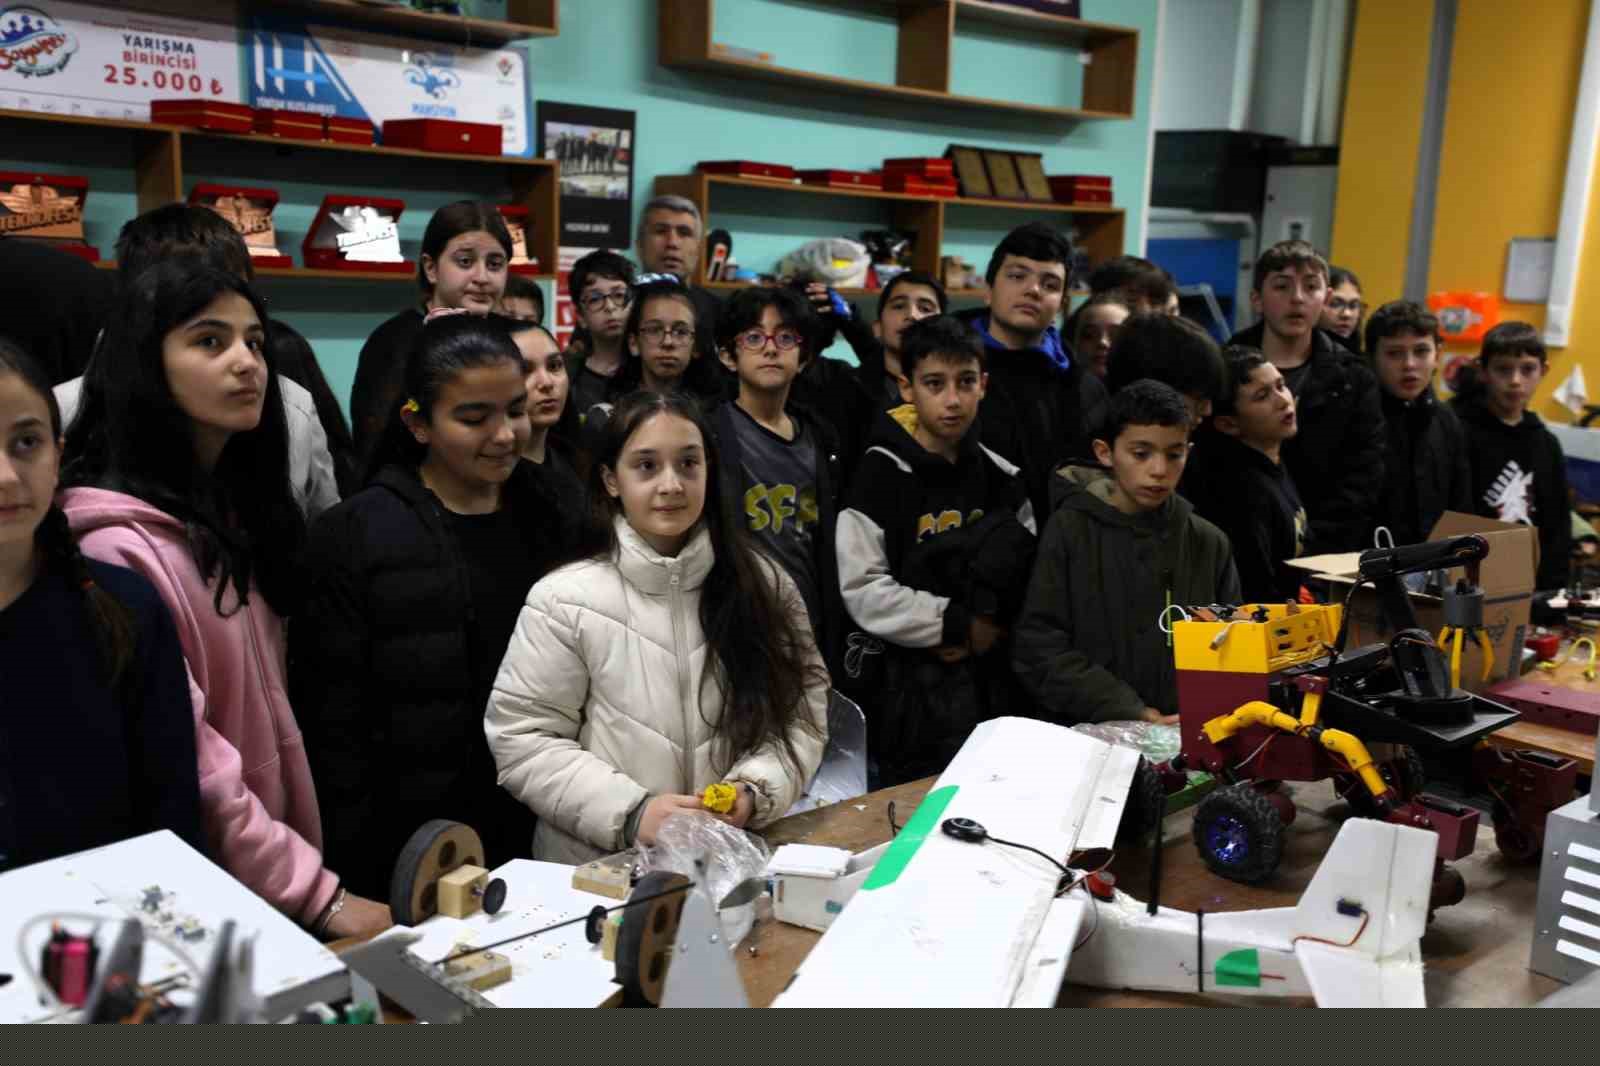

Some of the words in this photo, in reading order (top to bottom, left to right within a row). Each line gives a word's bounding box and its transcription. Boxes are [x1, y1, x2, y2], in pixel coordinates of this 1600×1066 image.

[122, 33, 196, 54] YARIŞMA
[122, 49, 197, 71] BİRİNCİSİ
[103, 63, 203, 93] 25.000
